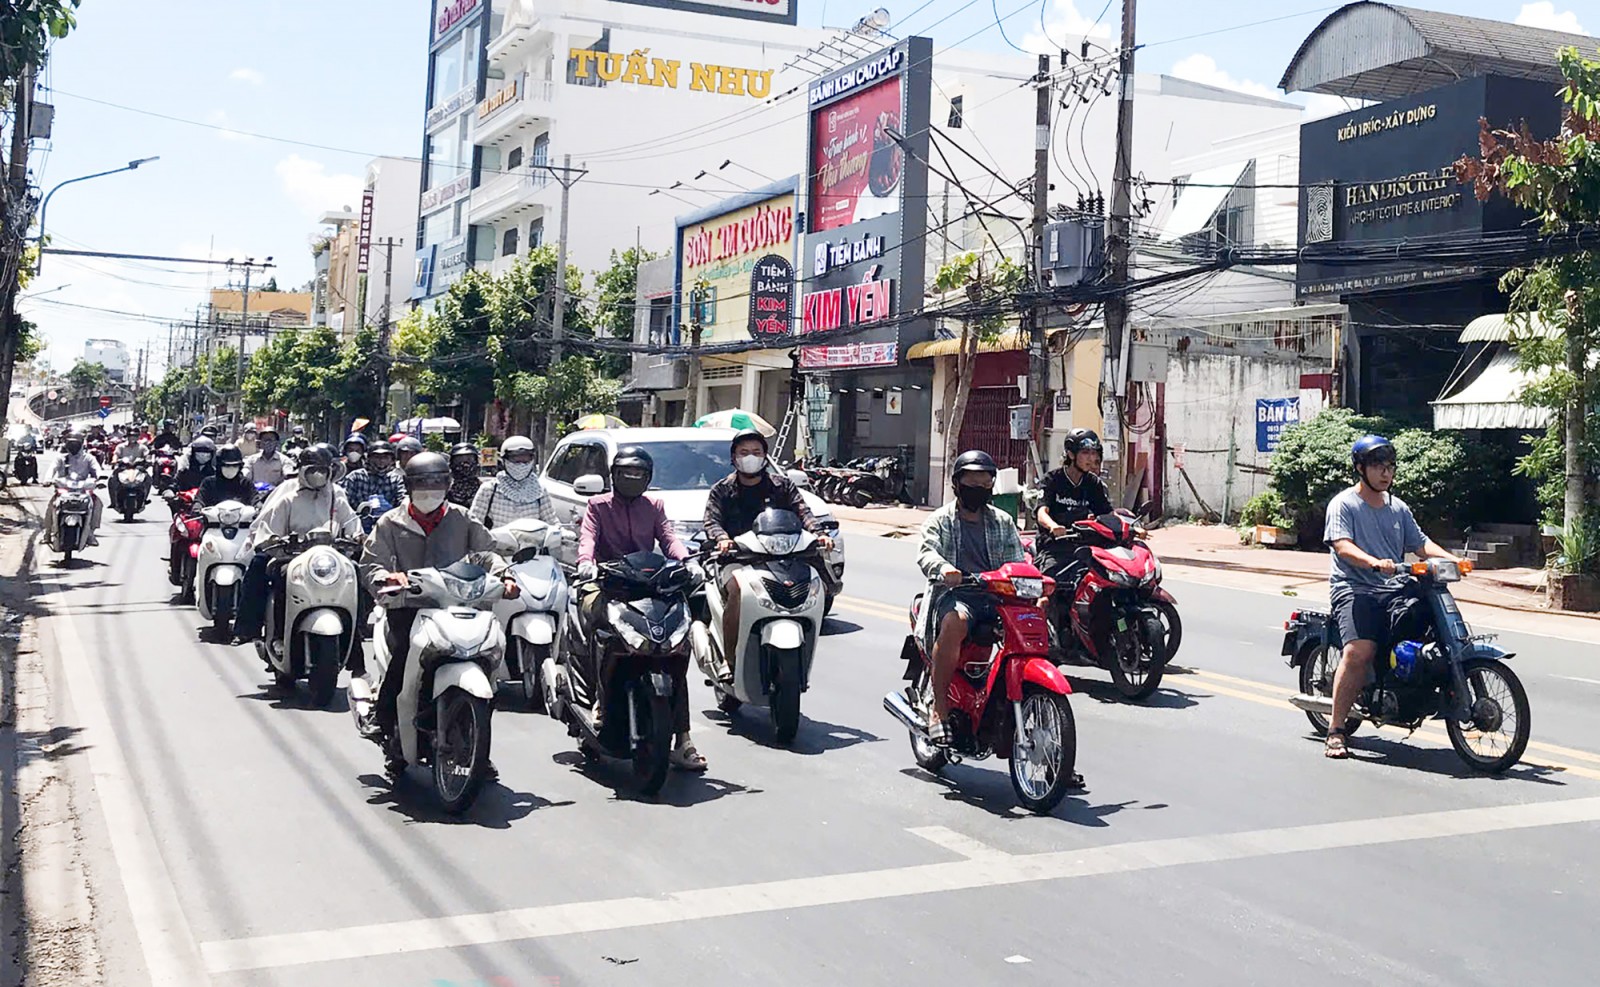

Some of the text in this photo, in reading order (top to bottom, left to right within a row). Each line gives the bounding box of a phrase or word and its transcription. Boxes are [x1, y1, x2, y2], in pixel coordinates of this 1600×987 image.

[570, 47, 774, 98] TUẤN NHƯ
[810, 46, 903, 105] BÁNH KEM CAO CẤP
[1338, 118, 1357, 141] KIẾN
[1407, 104, 1436, 127] DỰNG
[1349, 201, 1413, 225] ARCHITECTURE
[1413, 201, 1421, 213] &
[358, 248, 369, 270] NAM
[830, 233, 882, 271] TIỆM BÁNH
[760, 263, 787, 279] TIỆM
[757, 279, 788, 294] BÁNH
[757, 297, 786, 312] KIM
[801, 264, 891, 334] KIM YẾN
[756, 314, 788, 333] YẾN
[1258, 404, 1284, 422] BÁN
